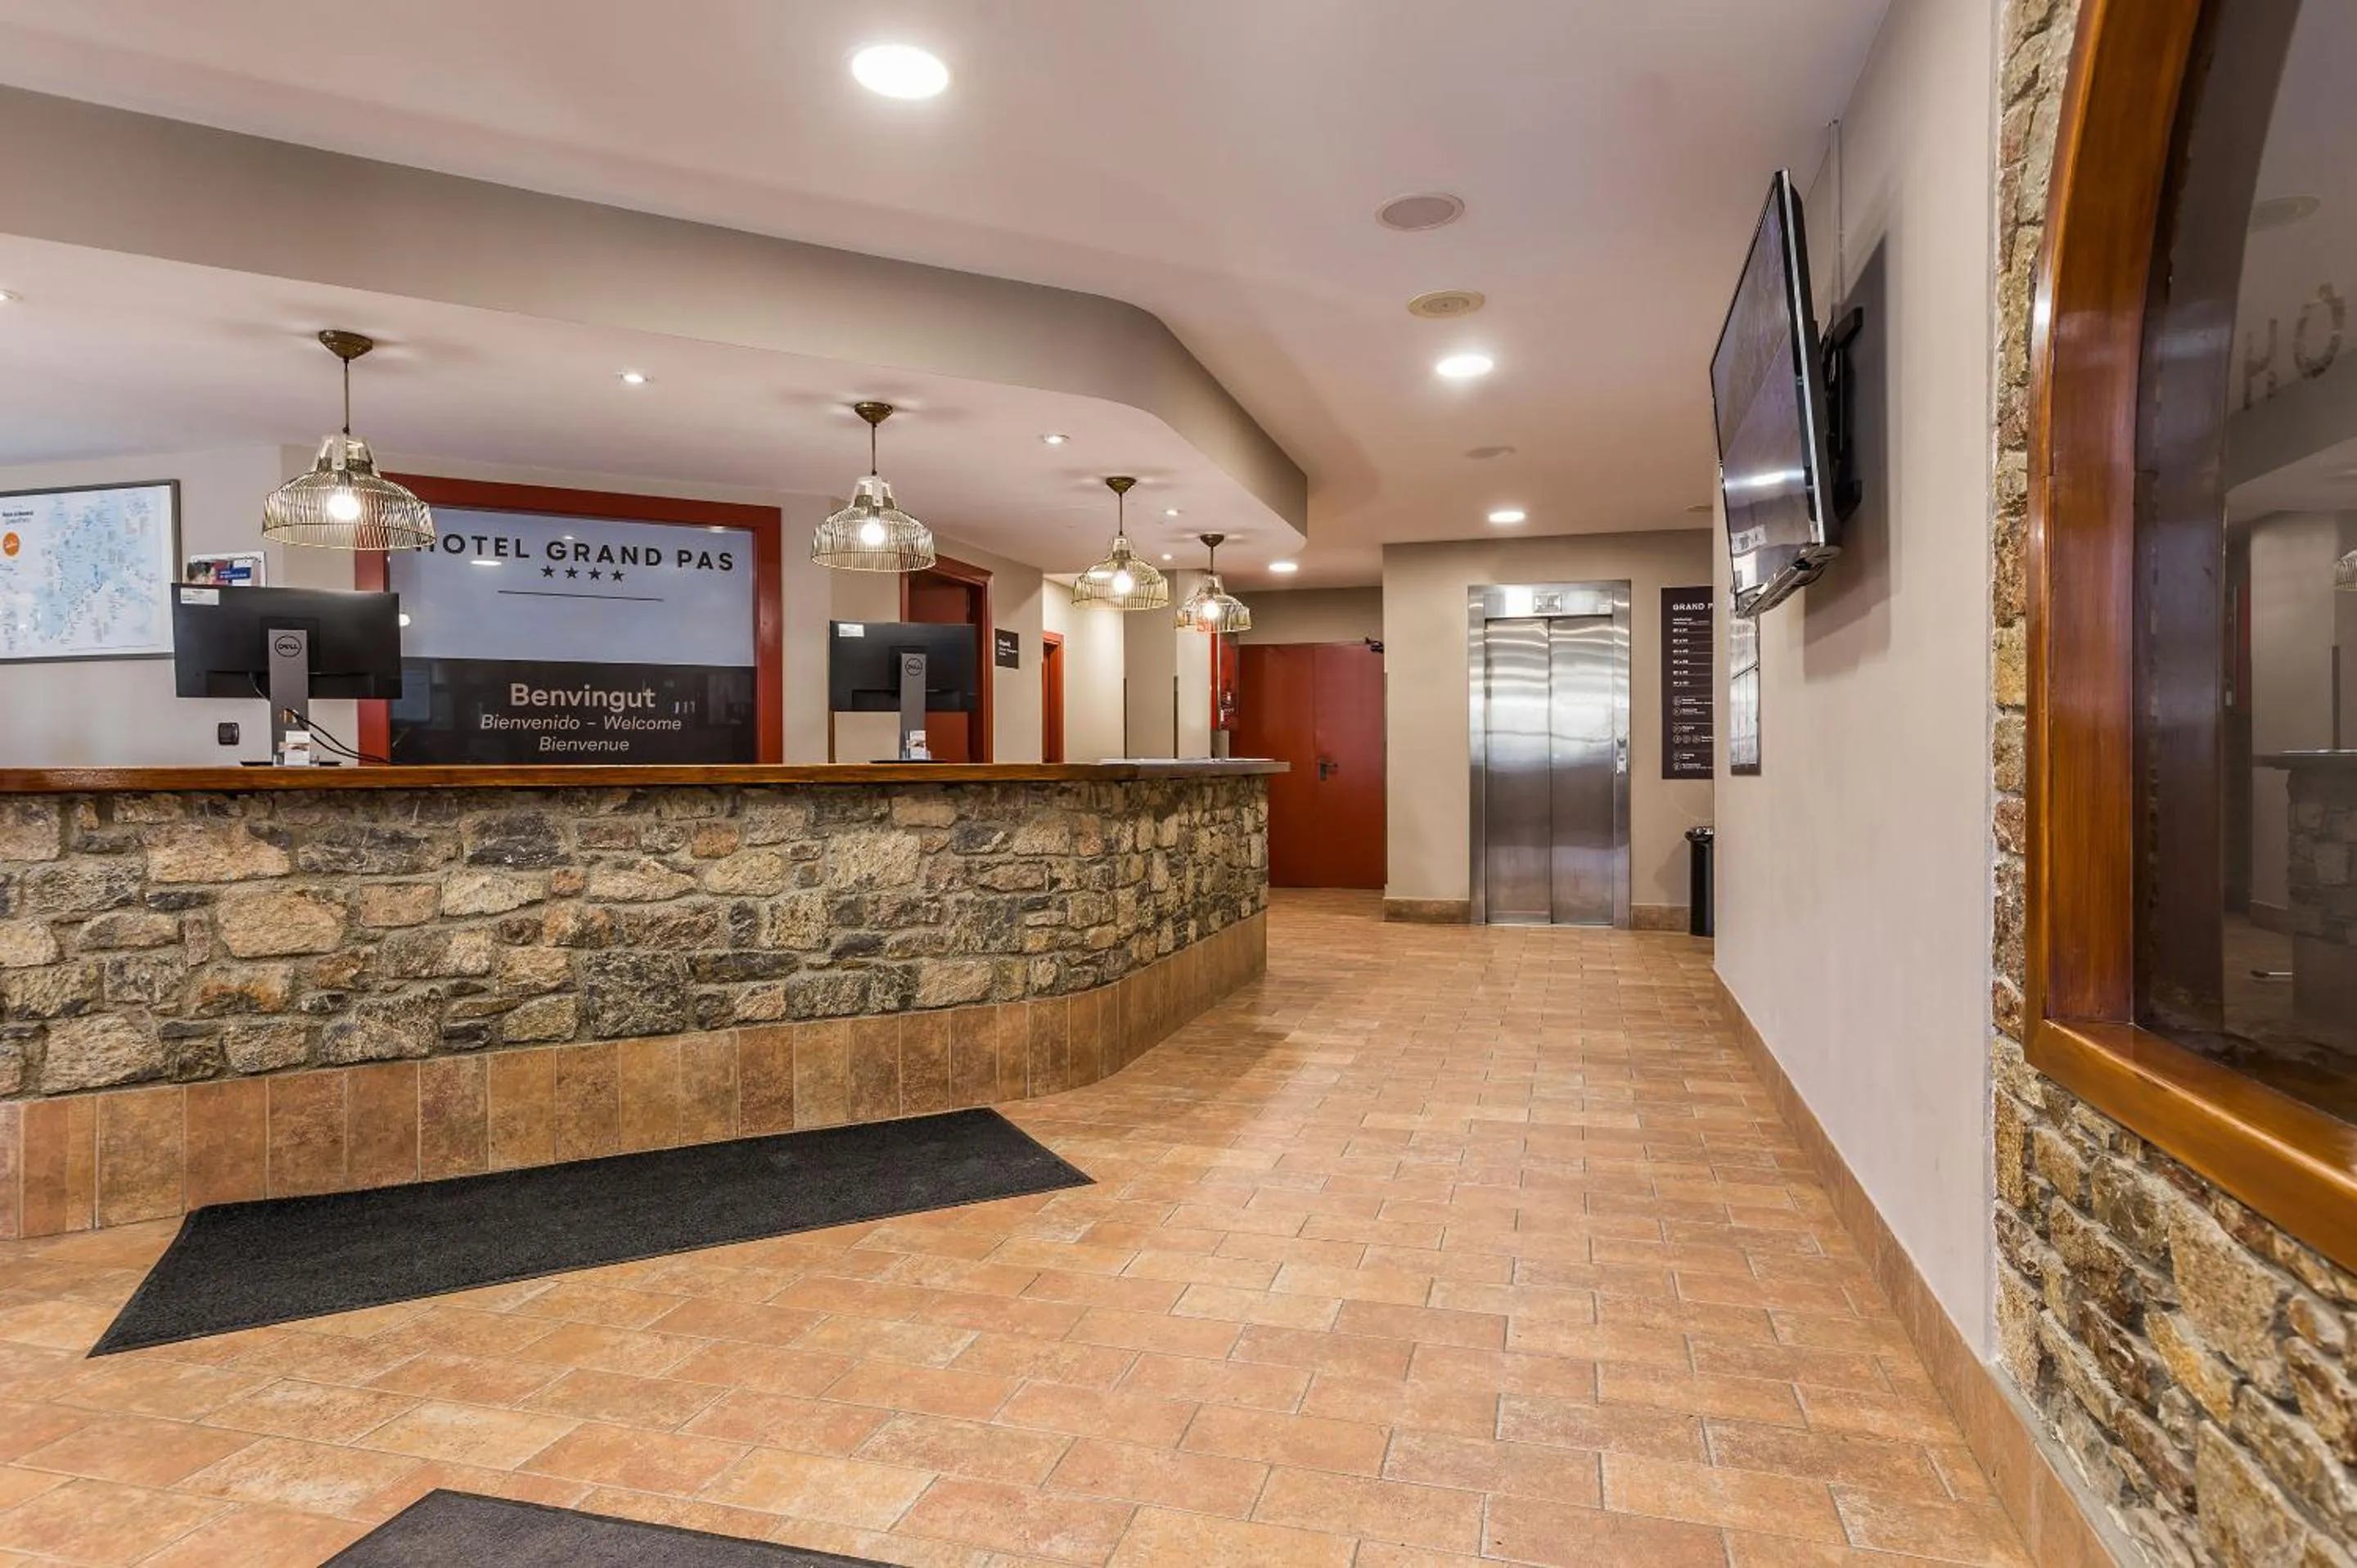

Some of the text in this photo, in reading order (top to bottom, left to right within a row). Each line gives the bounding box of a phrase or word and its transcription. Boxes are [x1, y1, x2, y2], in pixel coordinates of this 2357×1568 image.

[547, 541, 662, 566] GRAND
[678, 550, 734, 571] PAS
[1672, 602, 1706, 611] GRAND
[510, 683, 656, 712] Benvingut
[480, 714, 581, 730] Bienvenido
[604, 714, 682, 731] Welcome
[539, 737, 629, 751] Bienvenue
